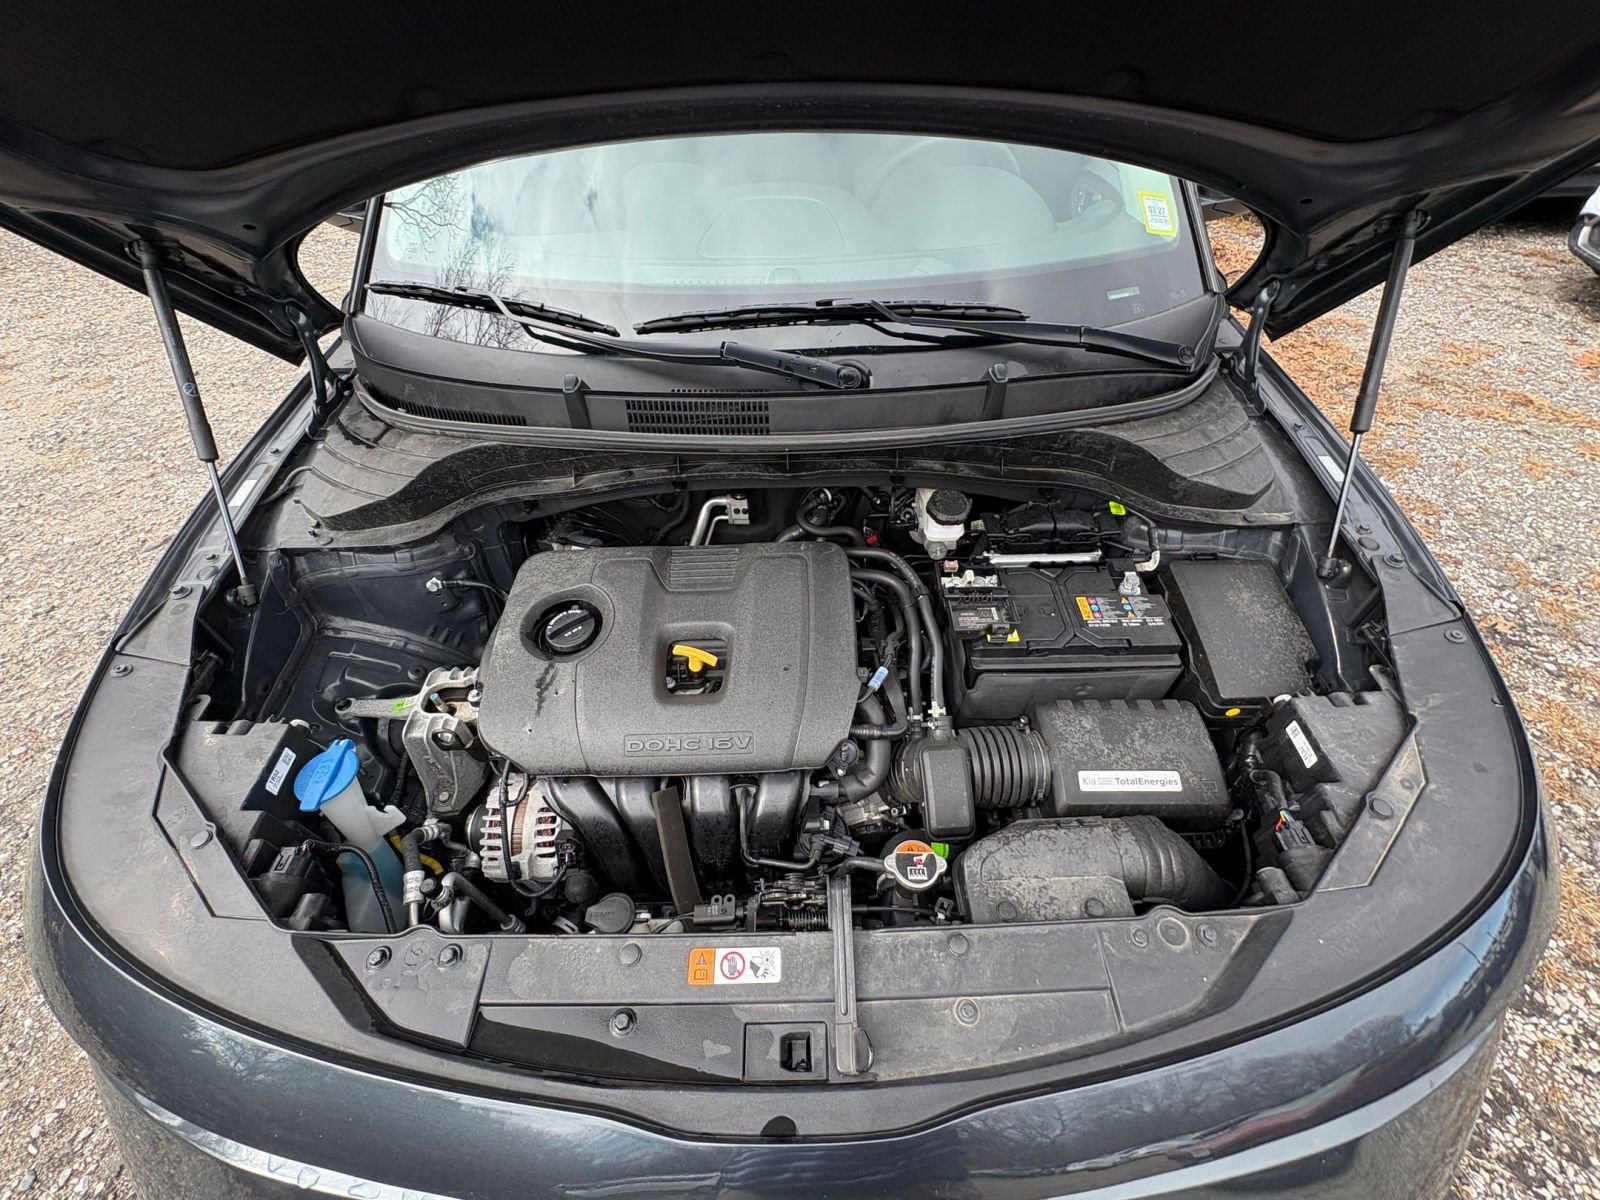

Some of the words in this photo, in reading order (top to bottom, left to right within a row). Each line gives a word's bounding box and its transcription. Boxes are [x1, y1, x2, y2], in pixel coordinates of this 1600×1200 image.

[1157, 206, 1166, 215] 27
[626, 738, 701, 753] DOHC
[708, 735, 752, 751] 16V
[1082, 776, 1096, 786] Kia
[1114, 777, 1179, 787] TotalEnergies
